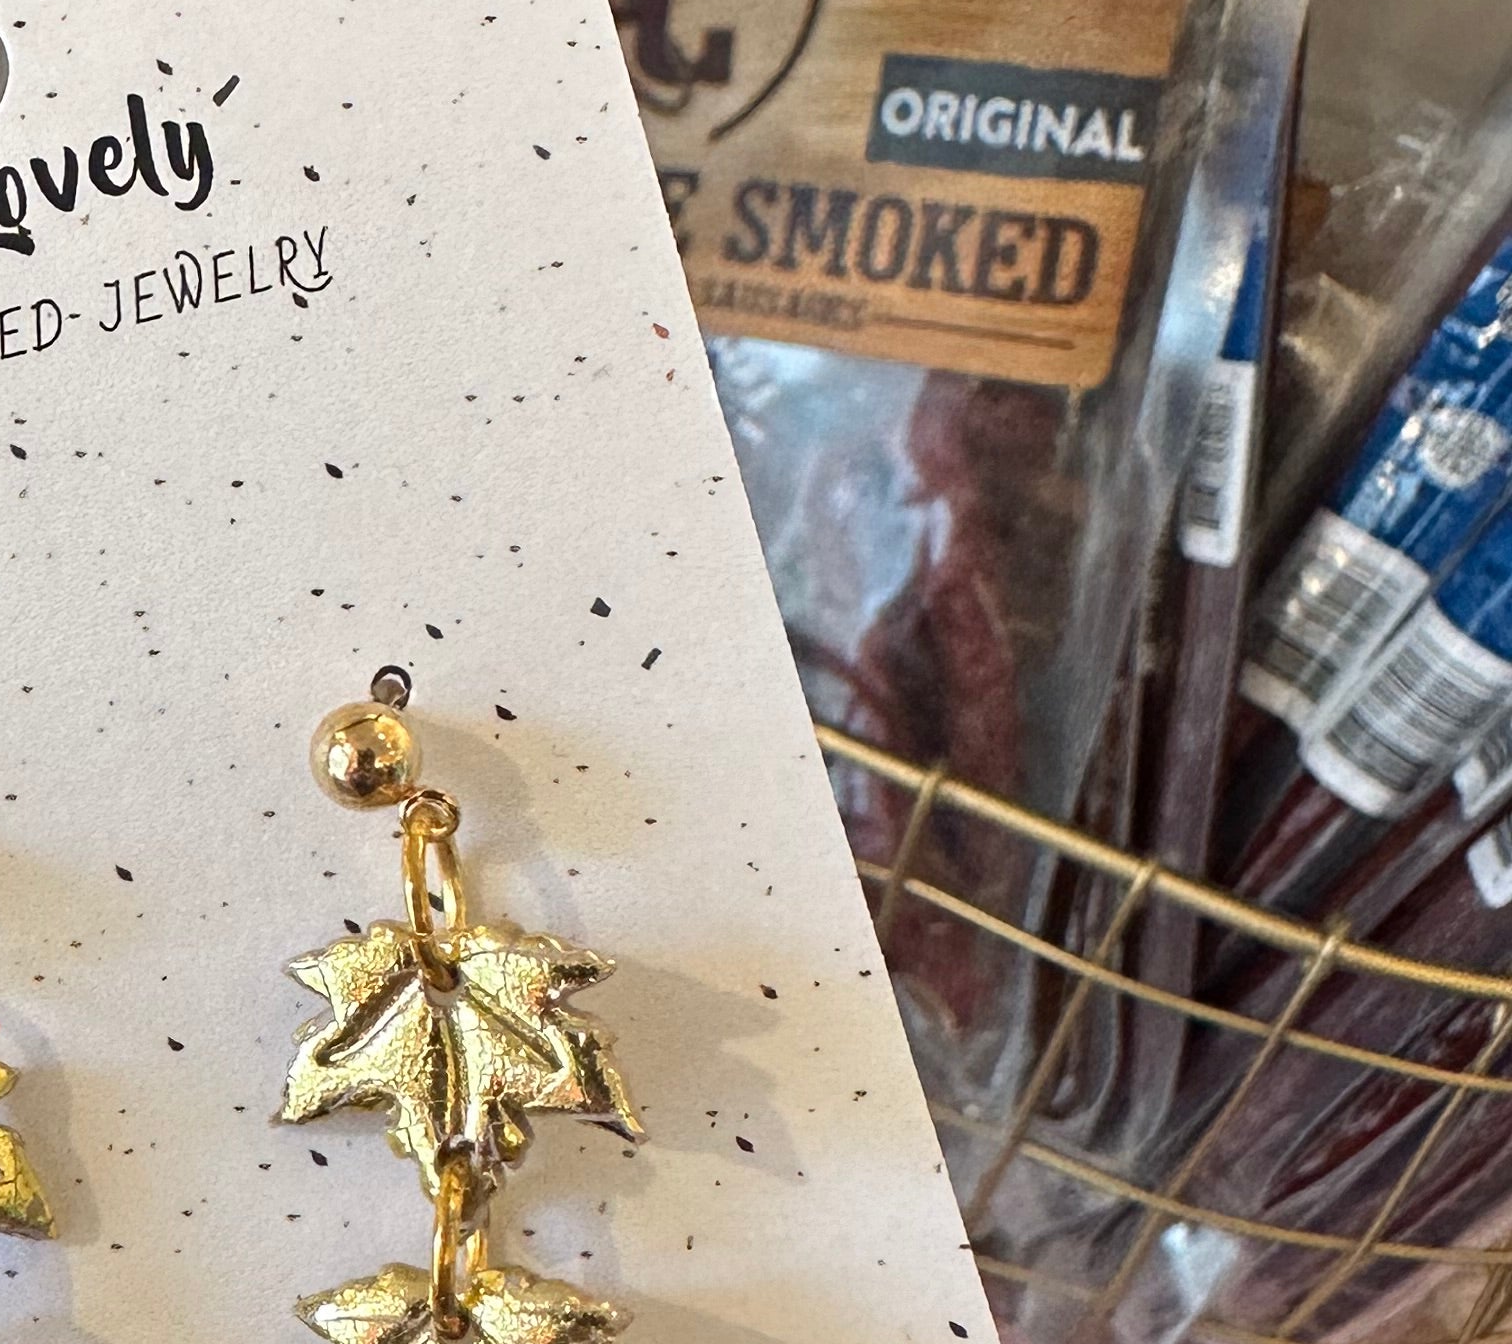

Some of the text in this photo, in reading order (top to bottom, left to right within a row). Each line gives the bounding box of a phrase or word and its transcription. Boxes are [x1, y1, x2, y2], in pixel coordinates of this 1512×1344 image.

[880, 86, 1145, 162] ORIGINAL
[99, 226, 333, 332] JEWELRY
[722, 177, 1101, 306] SMOKED
